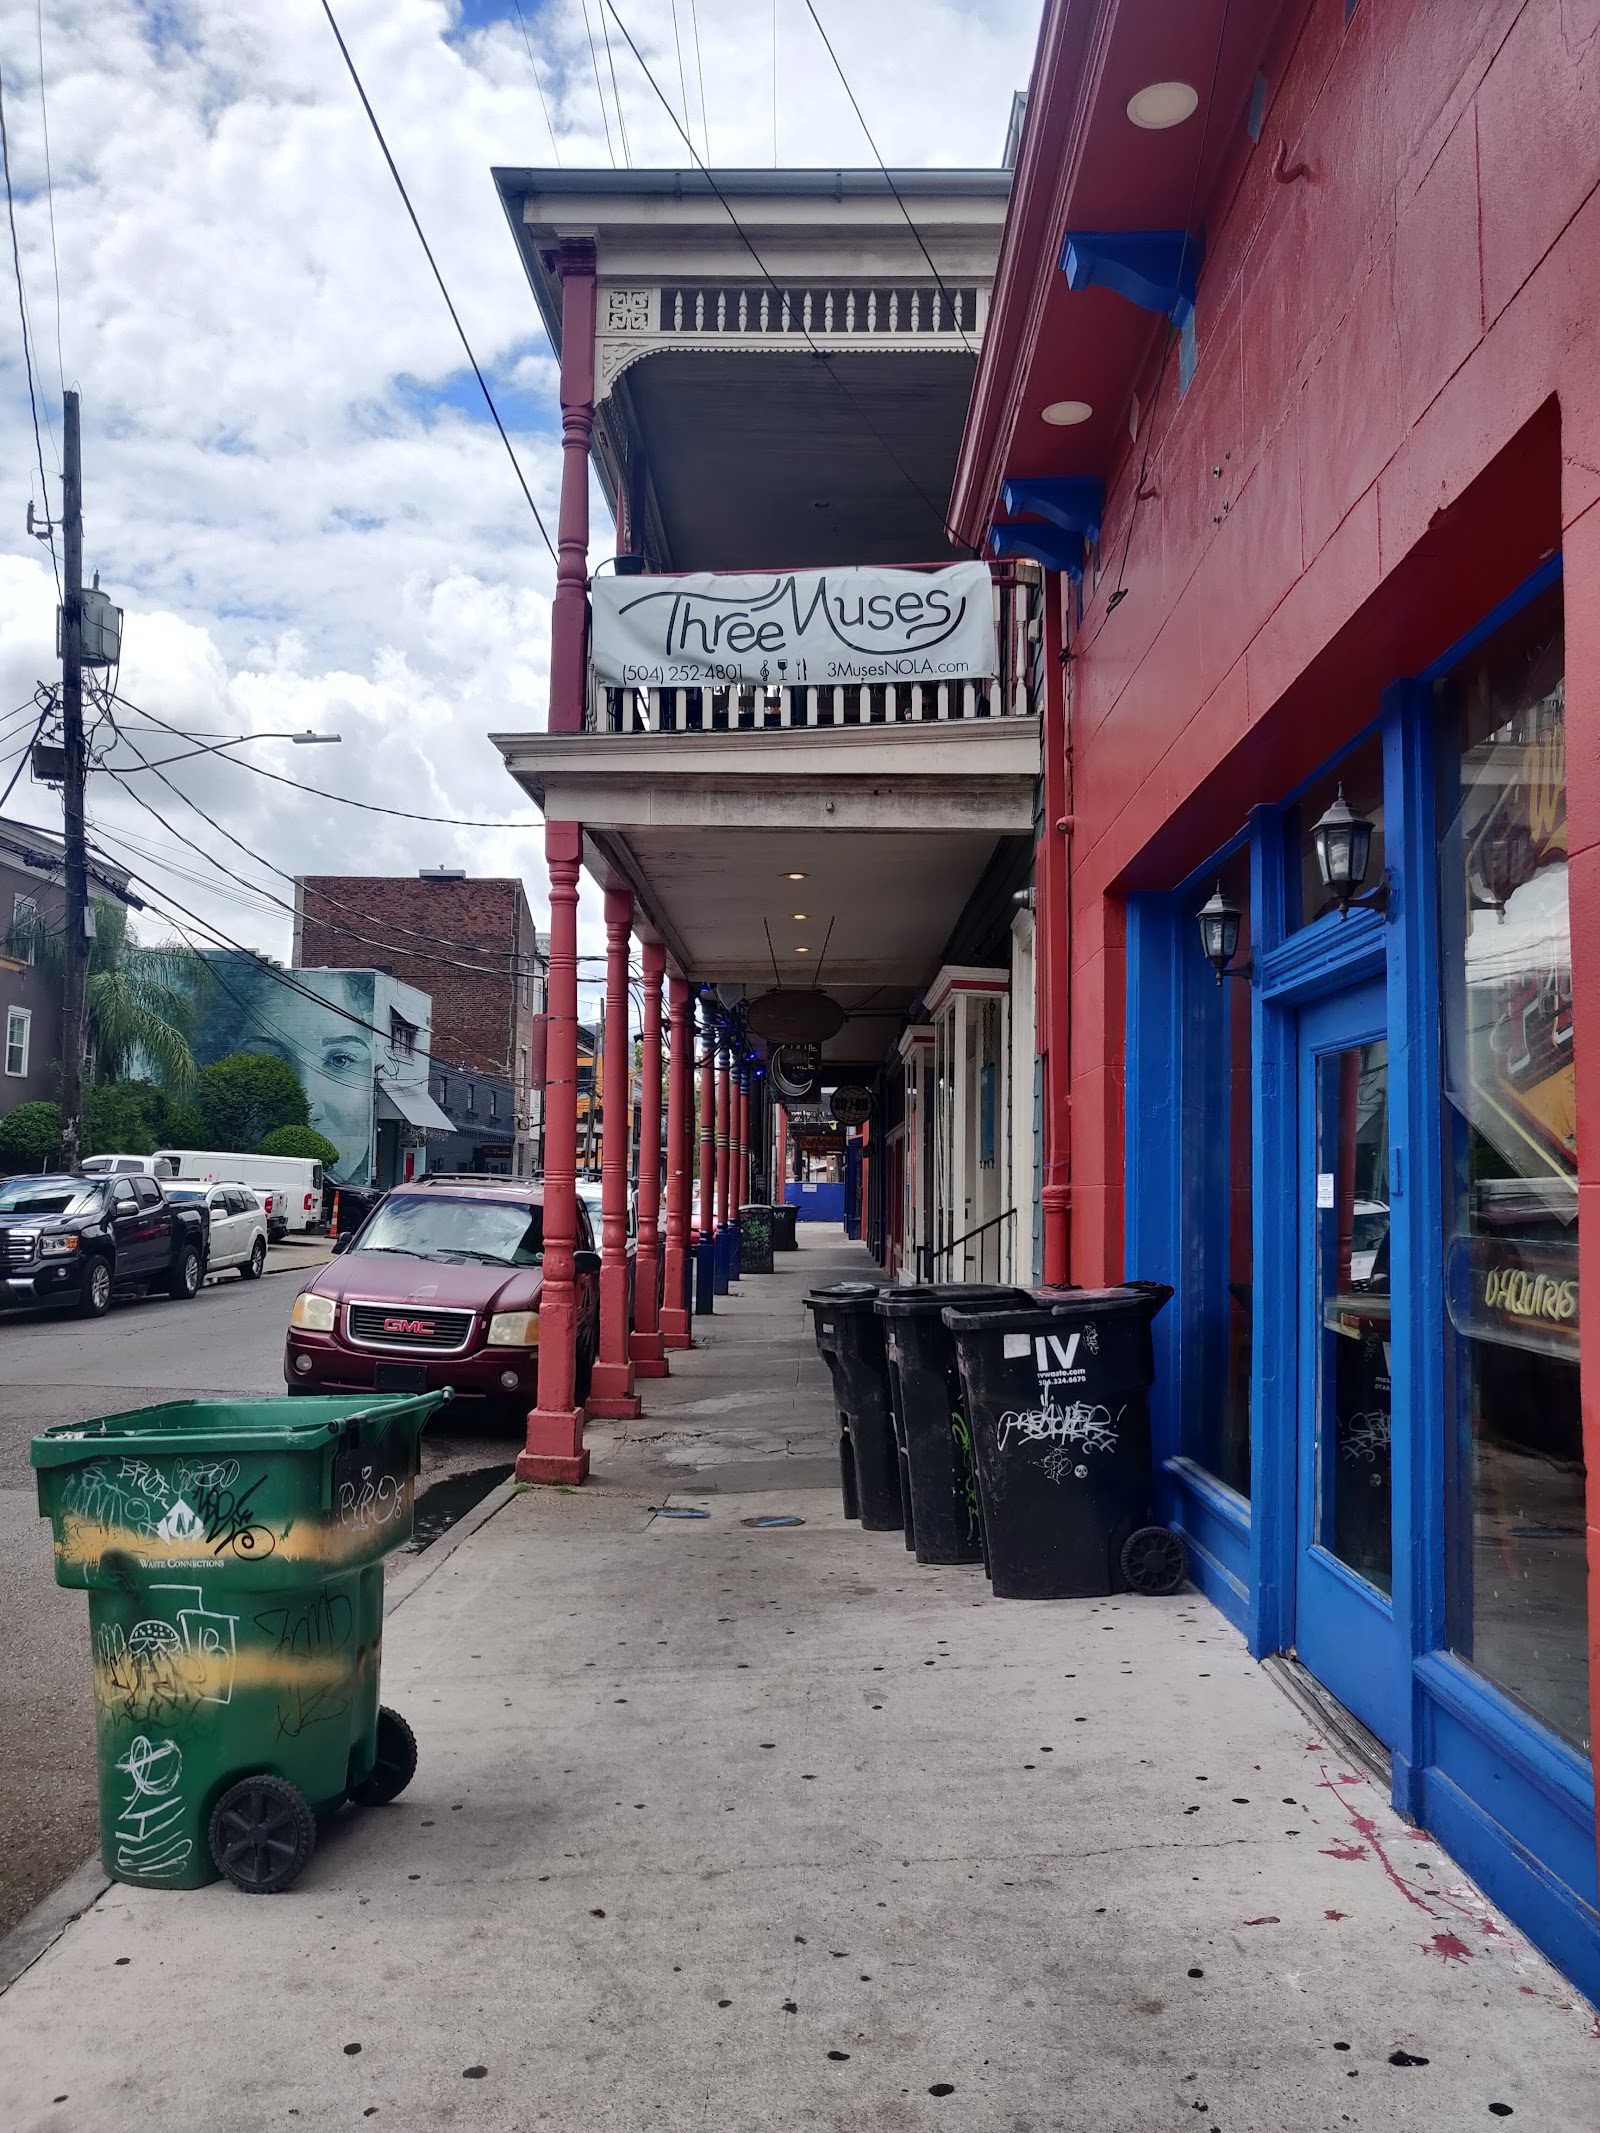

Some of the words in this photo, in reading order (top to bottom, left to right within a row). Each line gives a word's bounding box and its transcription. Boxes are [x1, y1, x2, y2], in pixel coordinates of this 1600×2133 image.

[619, 577, 788, 656] Three
[750, 575, 966, 656] Muses
[622, 665, 664, 683] (504)
[669, 664, 744, 682] 252-4801
[827, 658, 970, 679] 3MusesNOLA.com
[384, 1318, 435, 1334] GMC
[1035, 1333, 1080, 1371] IV
